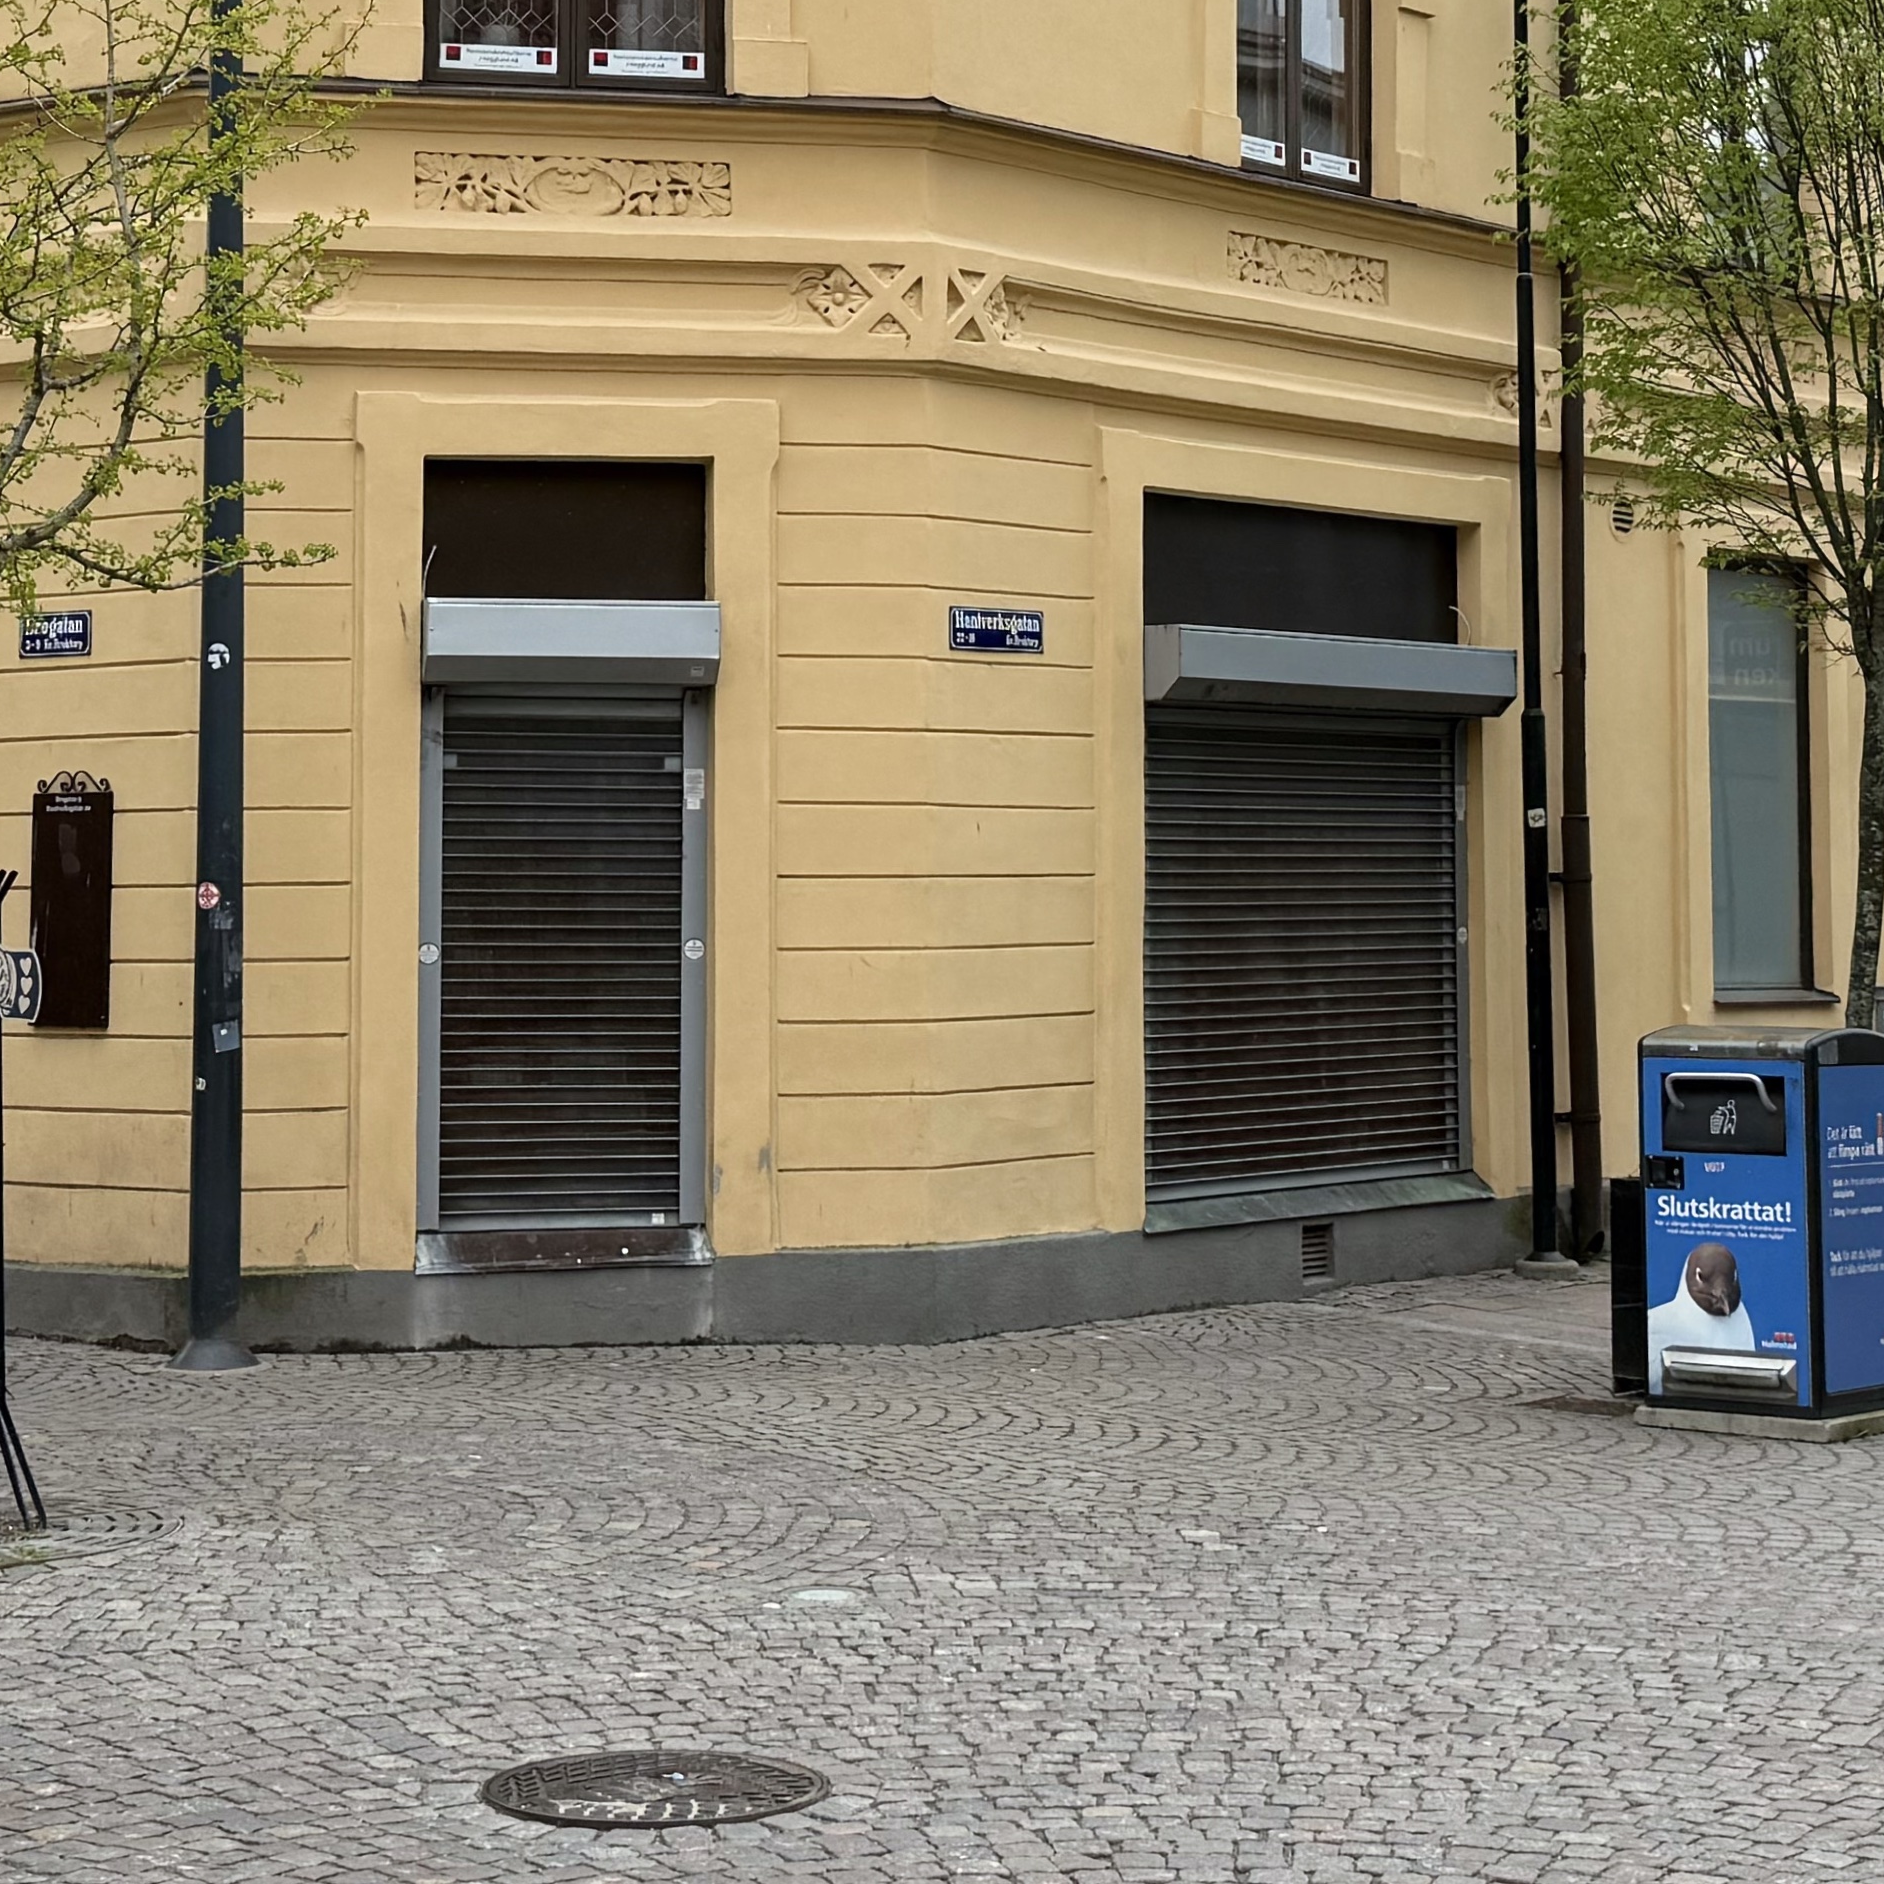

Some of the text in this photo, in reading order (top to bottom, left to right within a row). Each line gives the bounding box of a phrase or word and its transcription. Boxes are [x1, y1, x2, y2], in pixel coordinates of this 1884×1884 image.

[25, 616, 83, 639] Brogatan
[955, 610, 1040, 634] Hantverksgatan
[1657, 1194, 1792, 1223] Slutskrattat!
